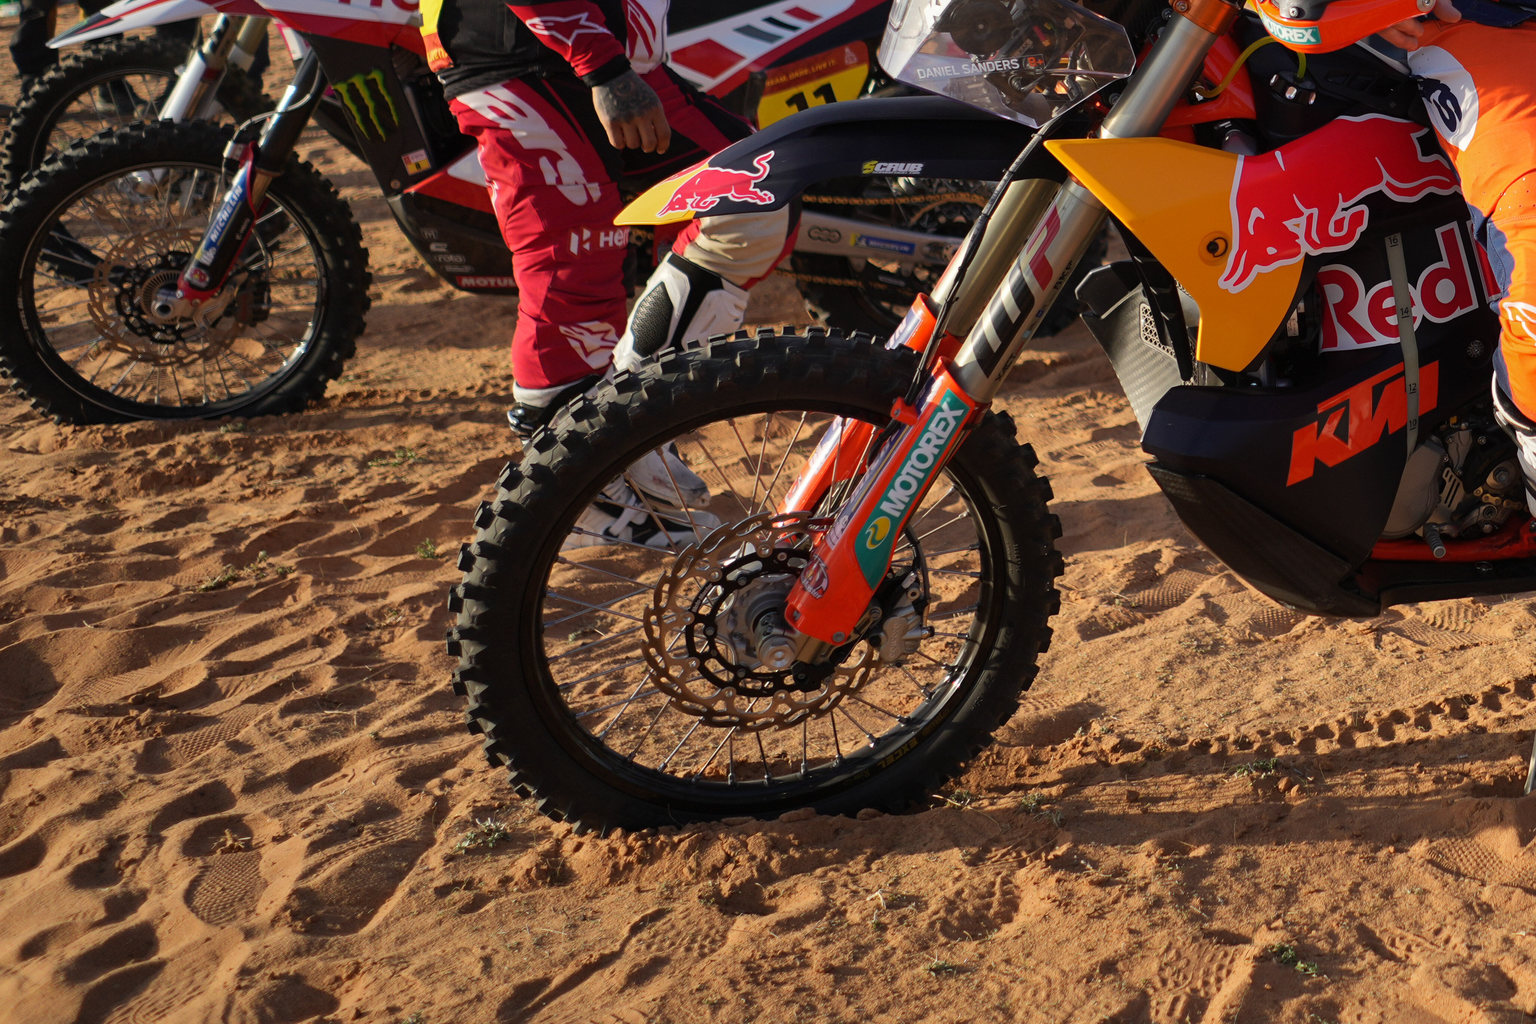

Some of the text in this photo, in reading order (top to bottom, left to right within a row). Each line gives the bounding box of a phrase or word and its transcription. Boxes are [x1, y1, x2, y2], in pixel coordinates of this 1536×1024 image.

[916, 65, 961, 80] DANIEL
[961, 58, 1021, 75] SANDERS
[862, 160, 924, 174] SCRUB
[210, 184, 243, 243] MICHELIN
[600, 228, 630, 248] Her
[1318, 220, 1480, 354] Red
[1286, 360, 1440, 488] KTM
[880, 401, 964, 519] MOTOREX
